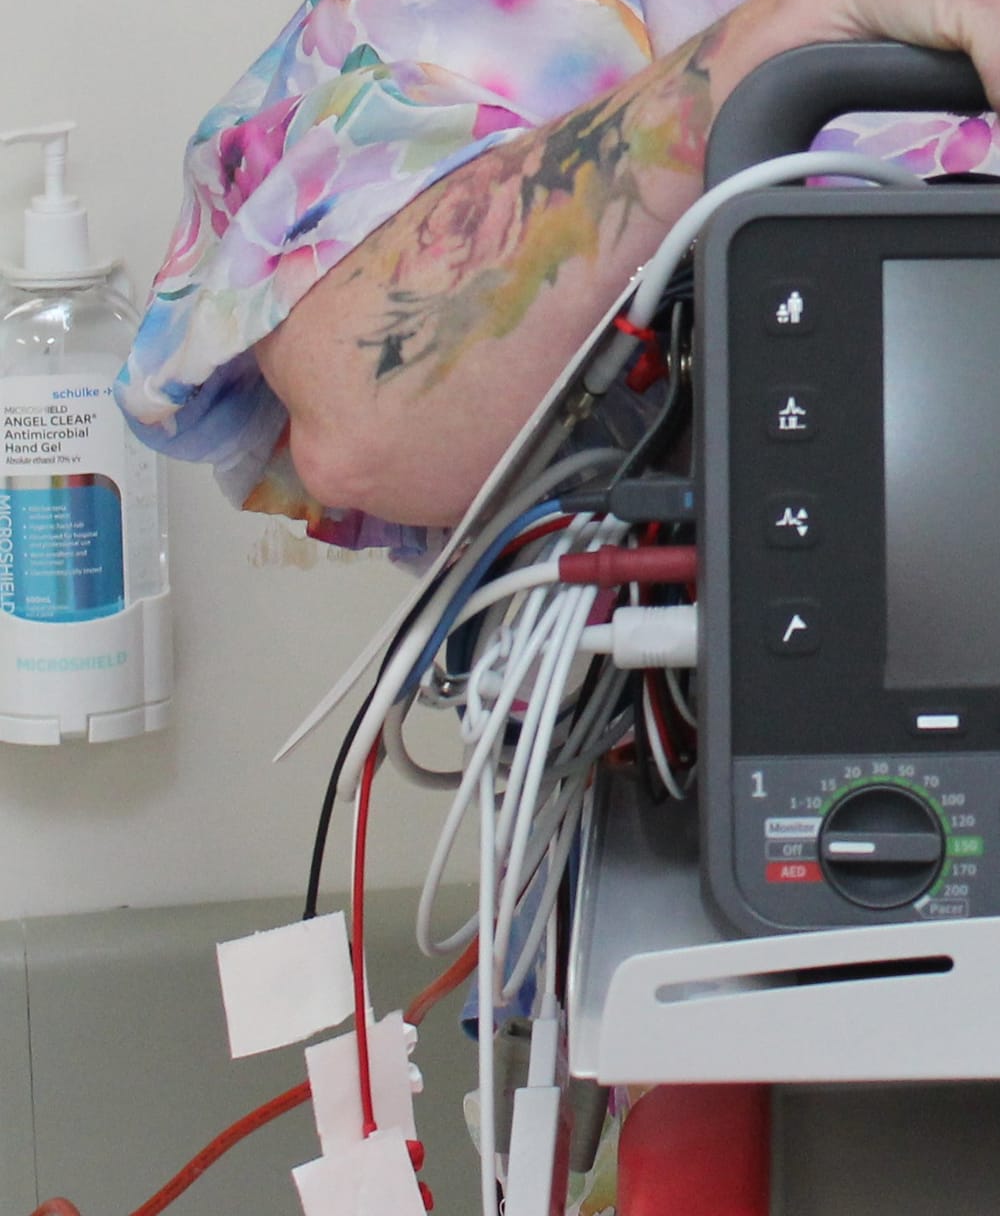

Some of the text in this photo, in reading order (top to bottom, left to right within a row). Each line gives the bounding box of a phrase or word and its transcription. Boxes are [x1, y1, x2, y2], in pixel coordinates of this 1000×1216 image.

[4, 416, 47, 427] ANGEL
[4, 427, 89, 440] Antimicrobial
[5, 441, 62, 453] Hand Gel
[33, 456, 56, 464] ethanol
[0, 495, 15, 614] MICROSHIELD
[844, 766, 862, 778] 20
[872, 762, 889, 774] 30
[898, 765, 915, 777] 50
[751, 771, 767, 798] 1
[820, 779, 836, 791] 15
[923, 776, 940, 788] 70
[790, 797, 822, 809] 1-10
[941, 794, 966, 806] 100
[951, 815, 976, 827] 120
[769, 822, 816, 833] Monitor
[783, 843, 803, 856] Off
[954, 839, 978, 851] 150
[780, 866, 807, 878] AED
[952, 864, 977, 876] 170
[943, 885, 969, 897] 200
[929, 903, 965, 916] Pacer
